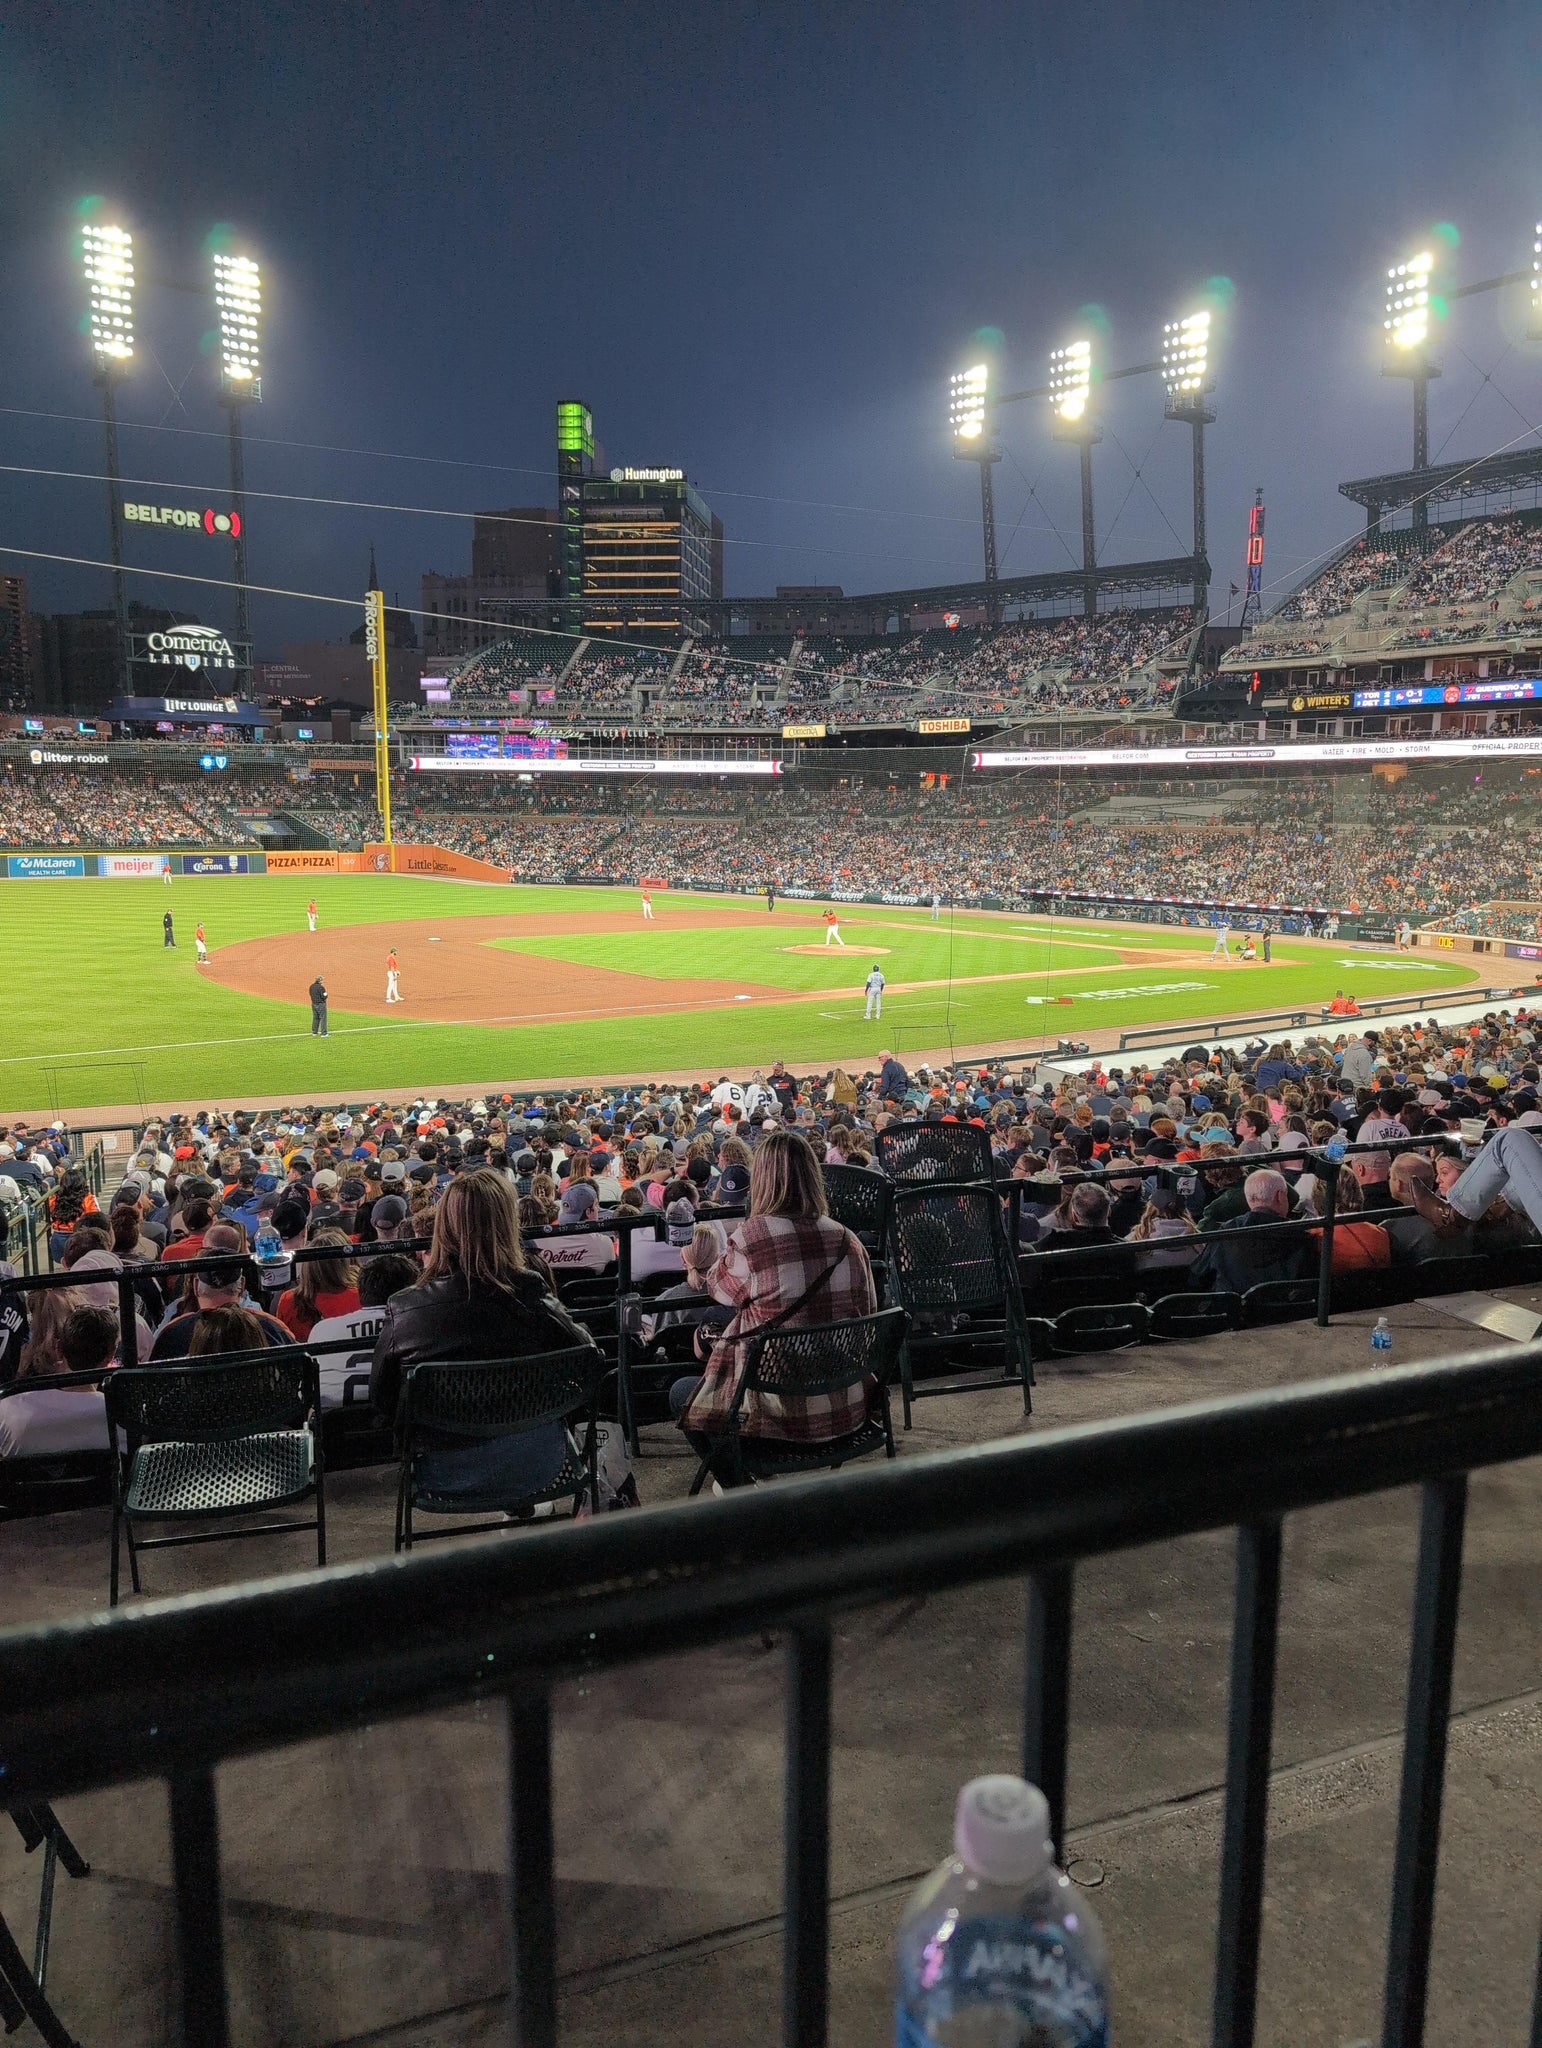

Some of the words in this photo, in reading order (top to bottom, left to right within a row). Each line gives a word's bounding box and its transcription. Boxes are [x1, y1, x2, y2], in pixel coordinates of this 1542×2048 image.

[625, 467, 683, 483] Huntington
[124, 503, 201, 528] BELFOR
[365, 605, 379, 661] Rocket
[148, 632, 234, 656] Comerica
[148, 653, 236, 669] LANDING
[1405, 689, 1423, 698] 0-1
[1475, 684, 1520, 692] GUERRERO
[1306, 694, 1351, 708] WINTER'S
[1363, 691, 1380, 699] TOR
[164, 699, 187, 713] Lite
[188, 702, 224, 712] LOUNGE
[921, 720, 968, 732] TOSHIBA
[530, 726, 563, 736] Motor
[563, 728, 585, 740] City
[593, 728, 619, 737] TIGER
[627, 728, 649, 737] CLUB
[1472, 743, 1505, 751] OFFICIAL
[33, 858, 76, 868] McLaren
[113, 857, 154, 874] meijer
[193, 861, 224, 873] Corona
[267, 857, 300, 868] PIZZA!
[303, 857, 335, 867] PIZZA!
[407, 858, 432, 869] Little
[745, 885, 768, 895] bet365
[729, 1087, 741, 1100] 6
[377, 1243, 395, 1251] 33AC
[543, 1248, 588, 1264] Detroit
[151, 1264, 170, 1272] 33AC
